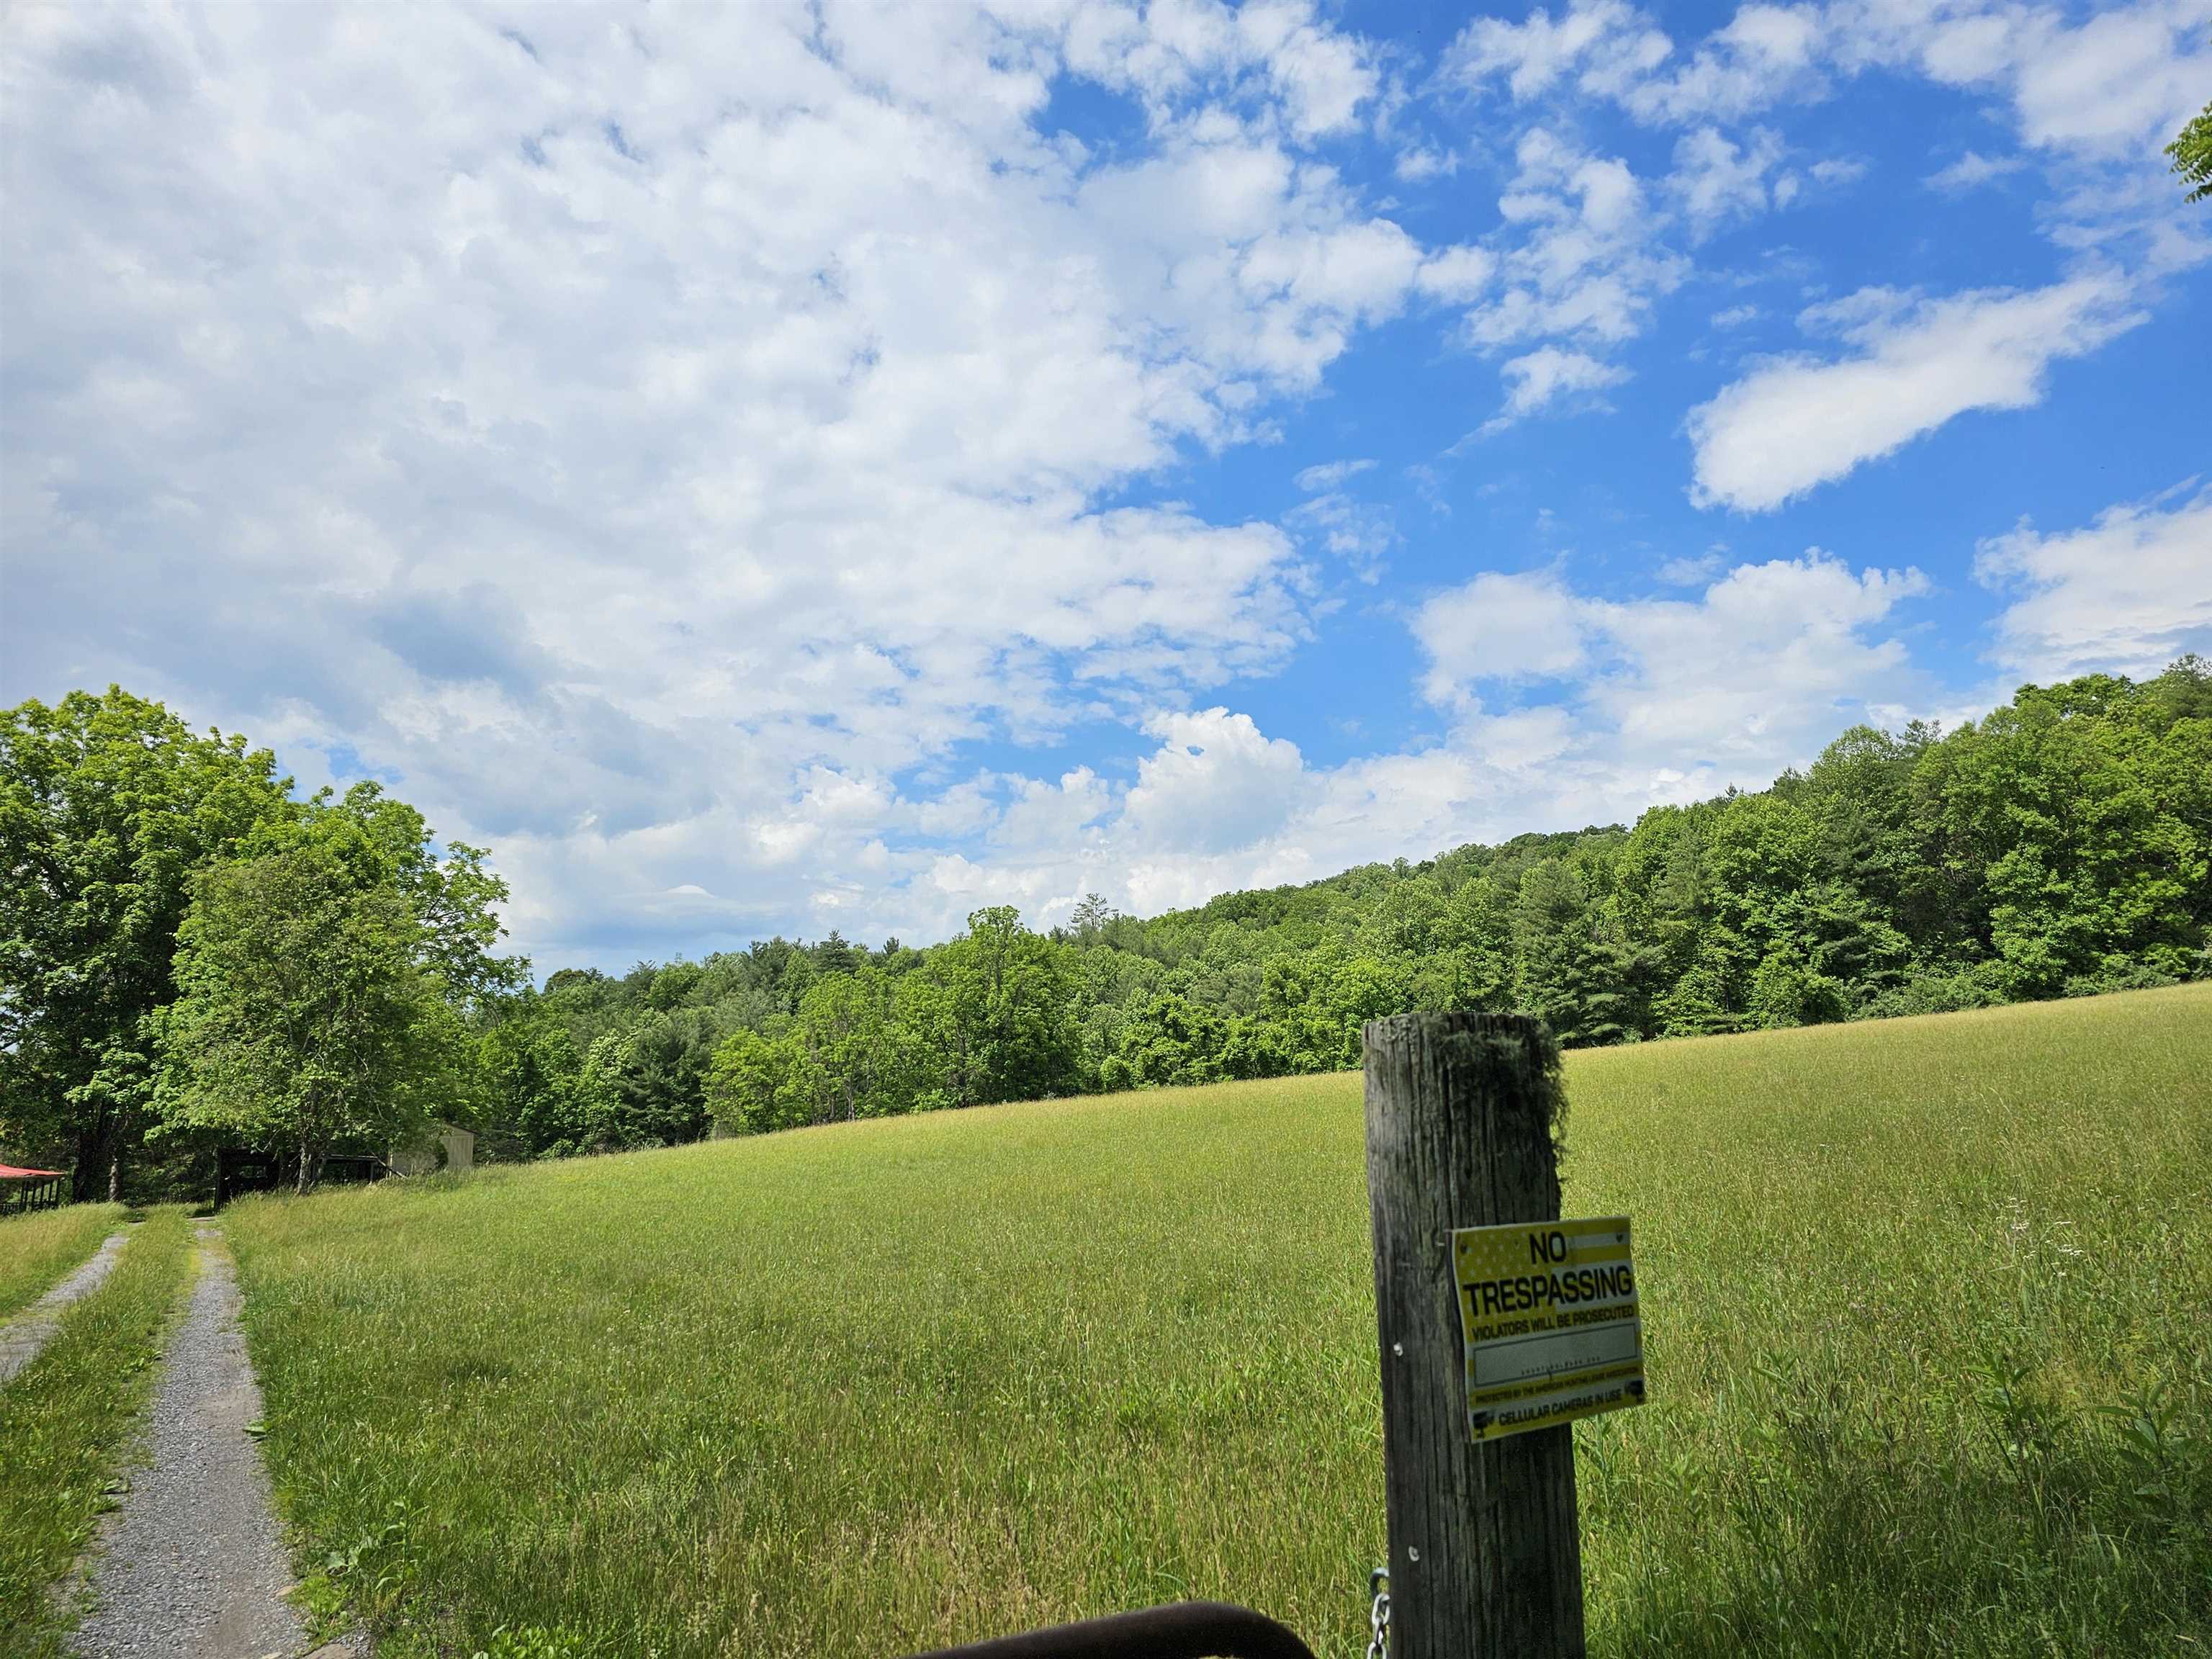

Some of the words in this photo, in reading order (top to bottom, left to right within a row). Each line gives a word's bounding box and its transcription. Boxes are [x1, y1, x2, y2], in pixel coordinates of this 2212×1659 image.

[1529, 1231, 1567, 1264] NO
[1463, 1265, 1632, 1316] TRESPASSING
[1472, 1319, 1529, 1341] VIOLATORS
[1532, 1316, 1555, 1332] WILL
[1557, 1313, 1570, 1328] BE
[1573, 1305, 1634, 1325] PROSECUTED
[1498, 1405, 1550, 1426] CELLULAR
[1552, 1396, 1593, 1415] CAMERAS
[1594, 1392, 1604, 1405] IN
[1605, 1389, 1622, 1402] USE
